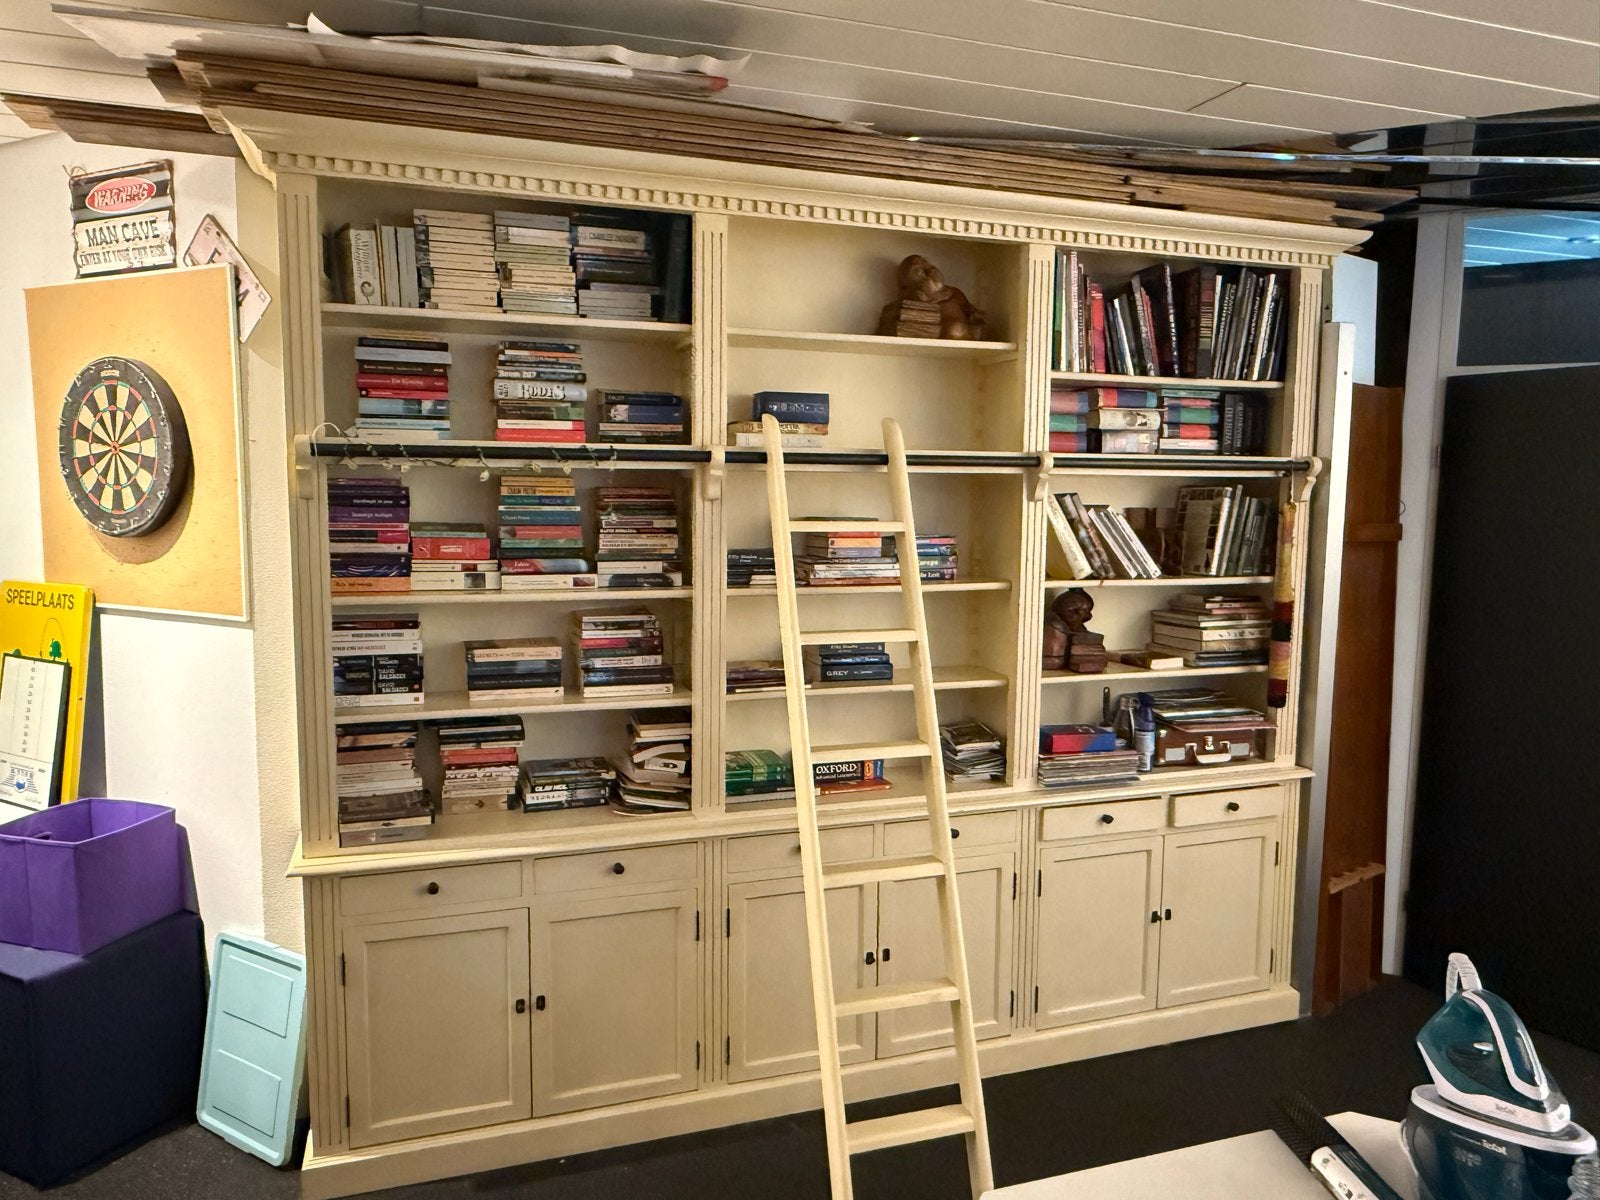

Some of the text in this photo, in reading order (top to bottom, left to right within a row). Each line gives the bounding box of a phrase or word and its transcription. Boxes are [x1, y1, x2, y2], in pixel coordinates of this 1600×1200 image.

[93, 184, 149, 208] WARNING
[85, 219, 160, 248] MAN CAVE
[6, 588, 75, 610] SPEELPLAATS
[815, 763, 858, 774] OXFORD
[1495, 1104, 1516, 1115] Tefal
[1481, 1139, 1507, 1155] Tefal
